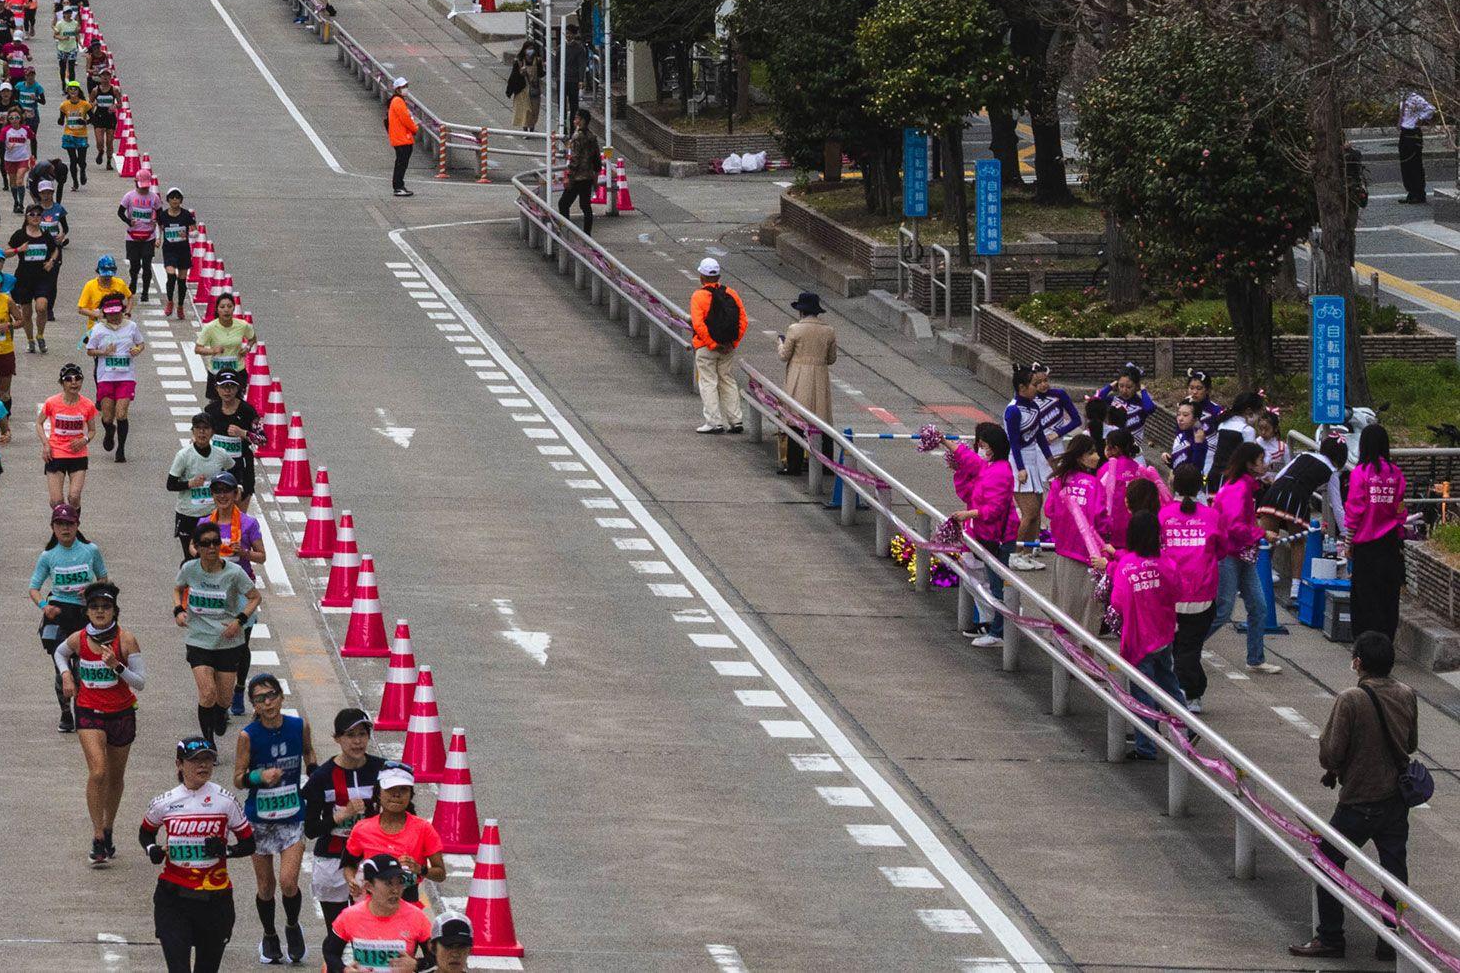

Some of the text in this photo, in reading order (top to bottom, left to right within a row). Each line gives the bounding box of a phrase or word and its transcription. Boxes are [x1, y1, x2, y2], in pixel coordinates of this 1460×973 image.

[987, 180, 998, 251] 自転車駐輪場
[1327, 325, 1340, 418] 自転車駐輪場
[1318, 383, 1326, 406] Space
[1166, 528, 1206, 537] おもてなし
[55, 572, 90, 586] E15452
[257, 793, 298, 812] D13370
[169, 845, 209, 859] D1315
